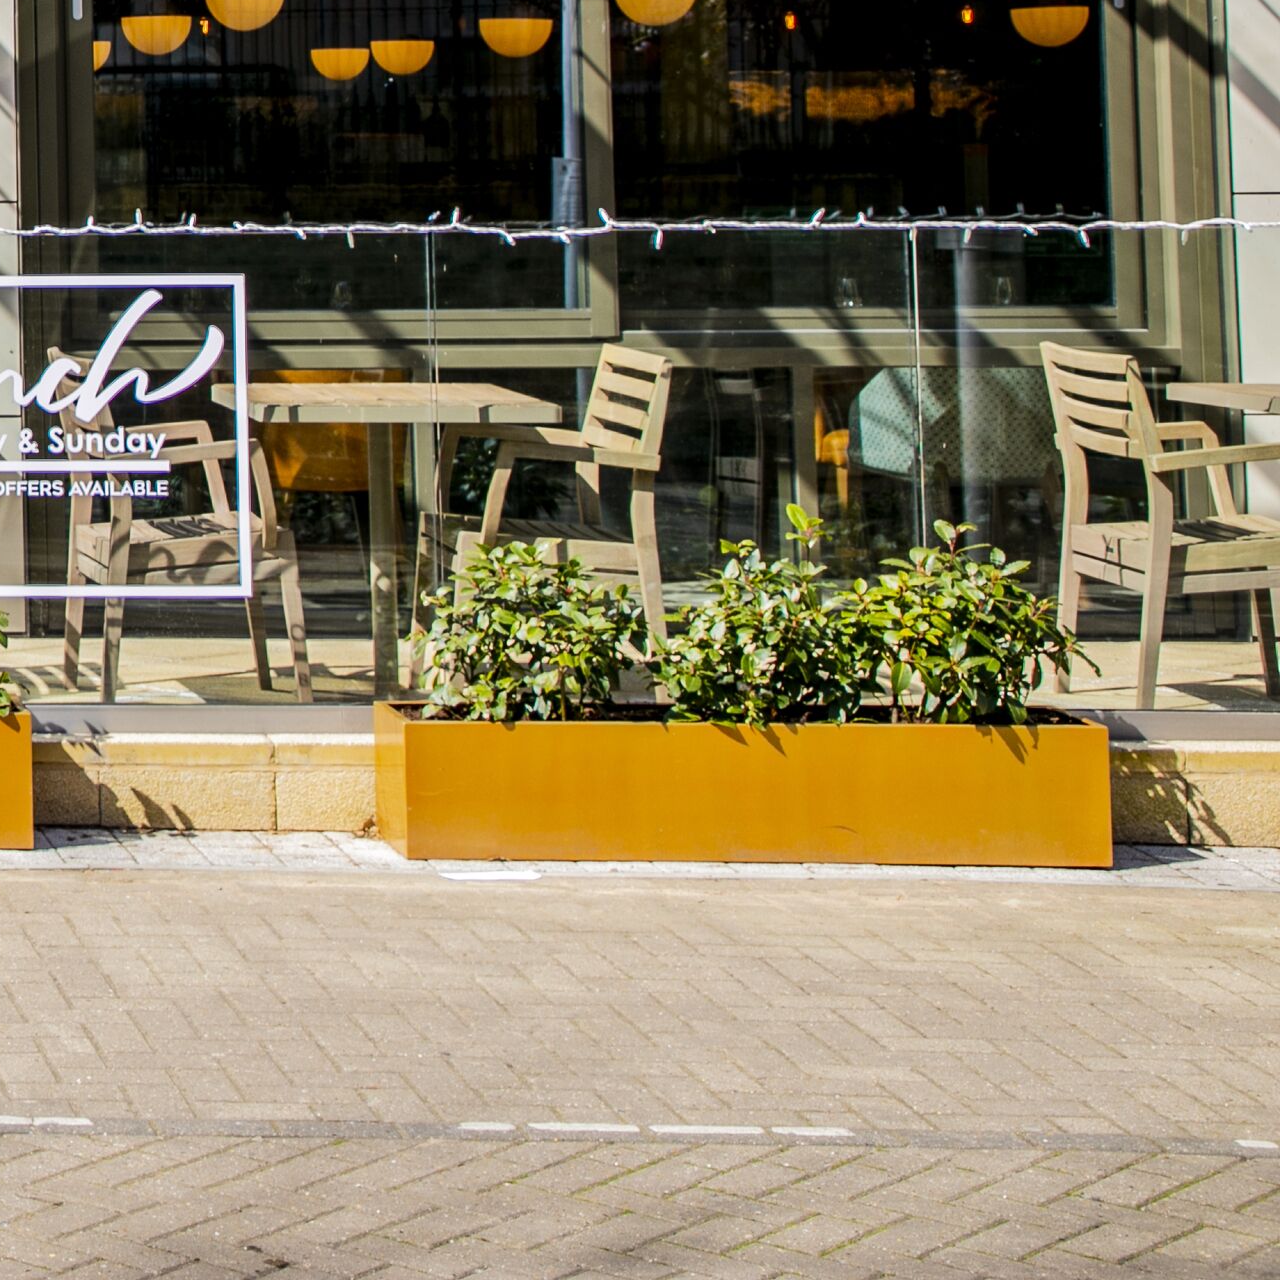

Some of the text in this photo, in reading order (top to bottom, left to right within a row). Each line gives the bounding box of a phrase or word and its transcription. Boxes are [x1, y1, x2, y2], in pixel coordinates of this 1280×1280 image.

[17, 428, 40, 455] &
[47, 426, 167, 460] Sunday
[68, 479, 170, 497] AVAILABLE
